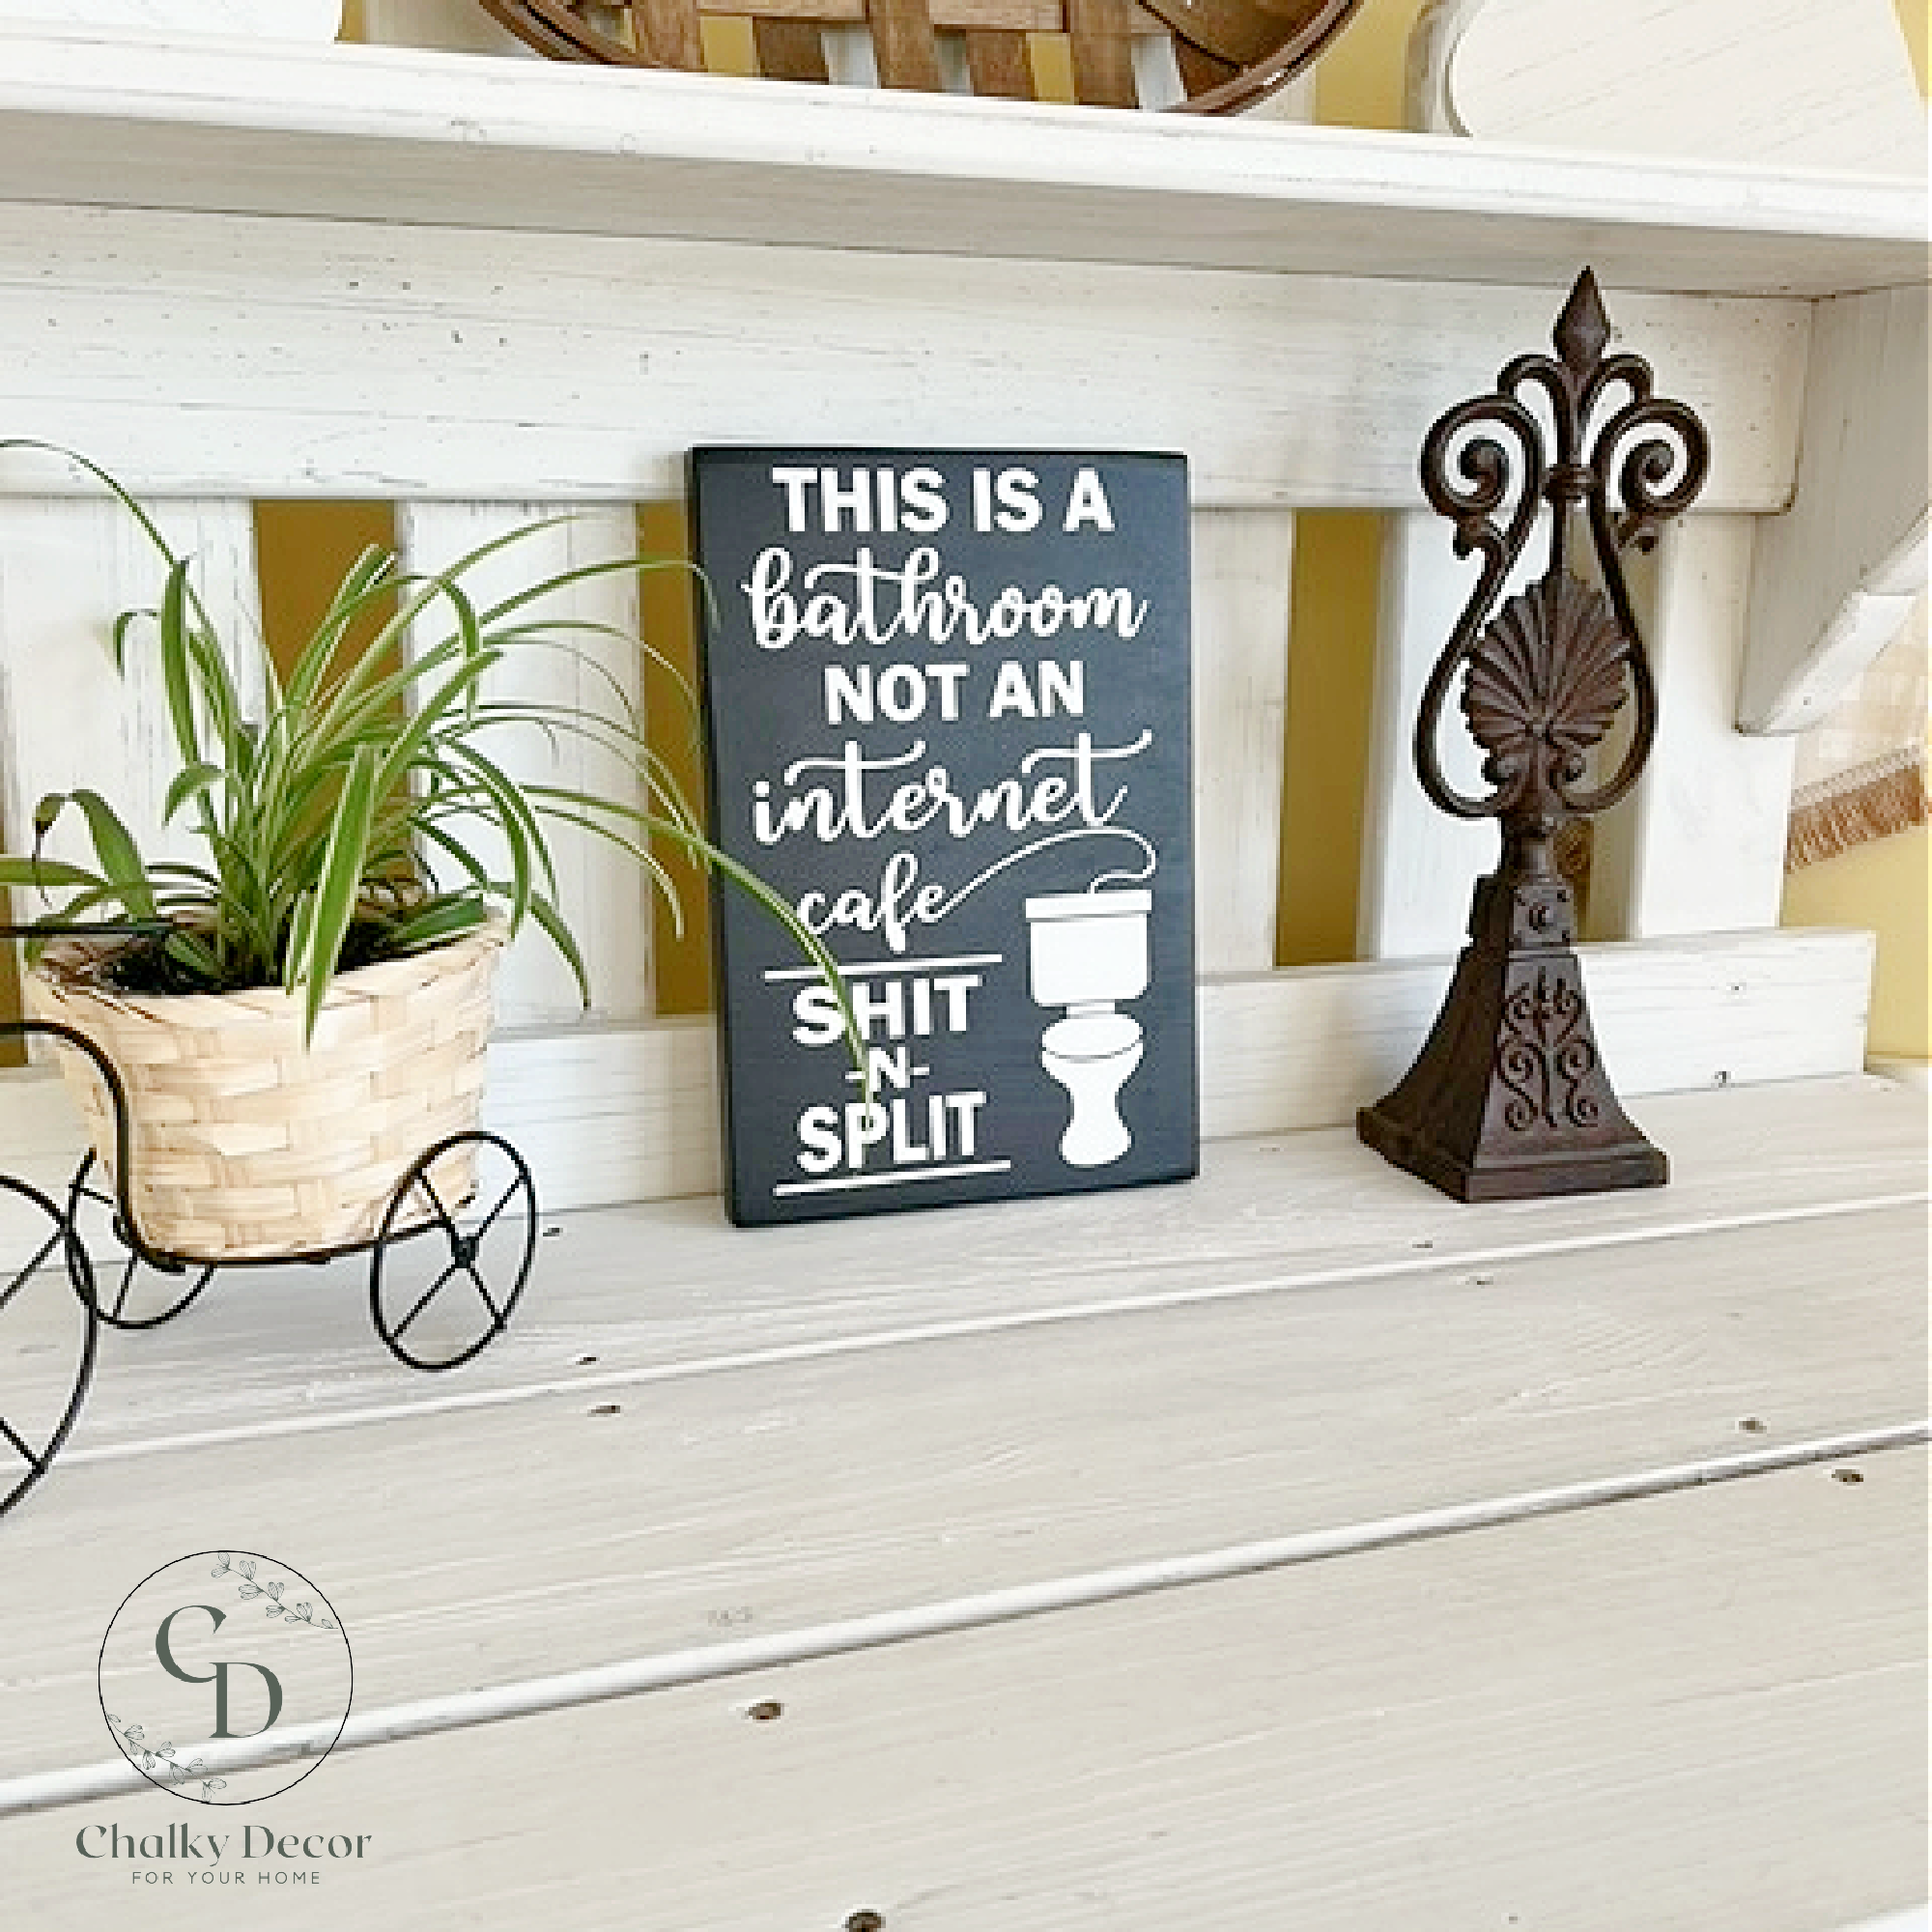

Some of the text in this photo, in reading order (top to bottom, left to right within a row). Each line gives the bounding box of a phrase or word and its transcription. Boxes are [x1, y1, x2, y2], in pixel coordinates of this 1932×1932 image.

[772, 467, 1117, 532] THIS IS A
[740, 546, 1149, 649] bathroom
[824, 660, 1085, 725] NOT AN
[752, 727, 1153, 845] internet
[797, 851, 952, 953] cafe
[792, 974, 983, 1046] SHIT
[796, 1091, 987, 1173] SPLIT
